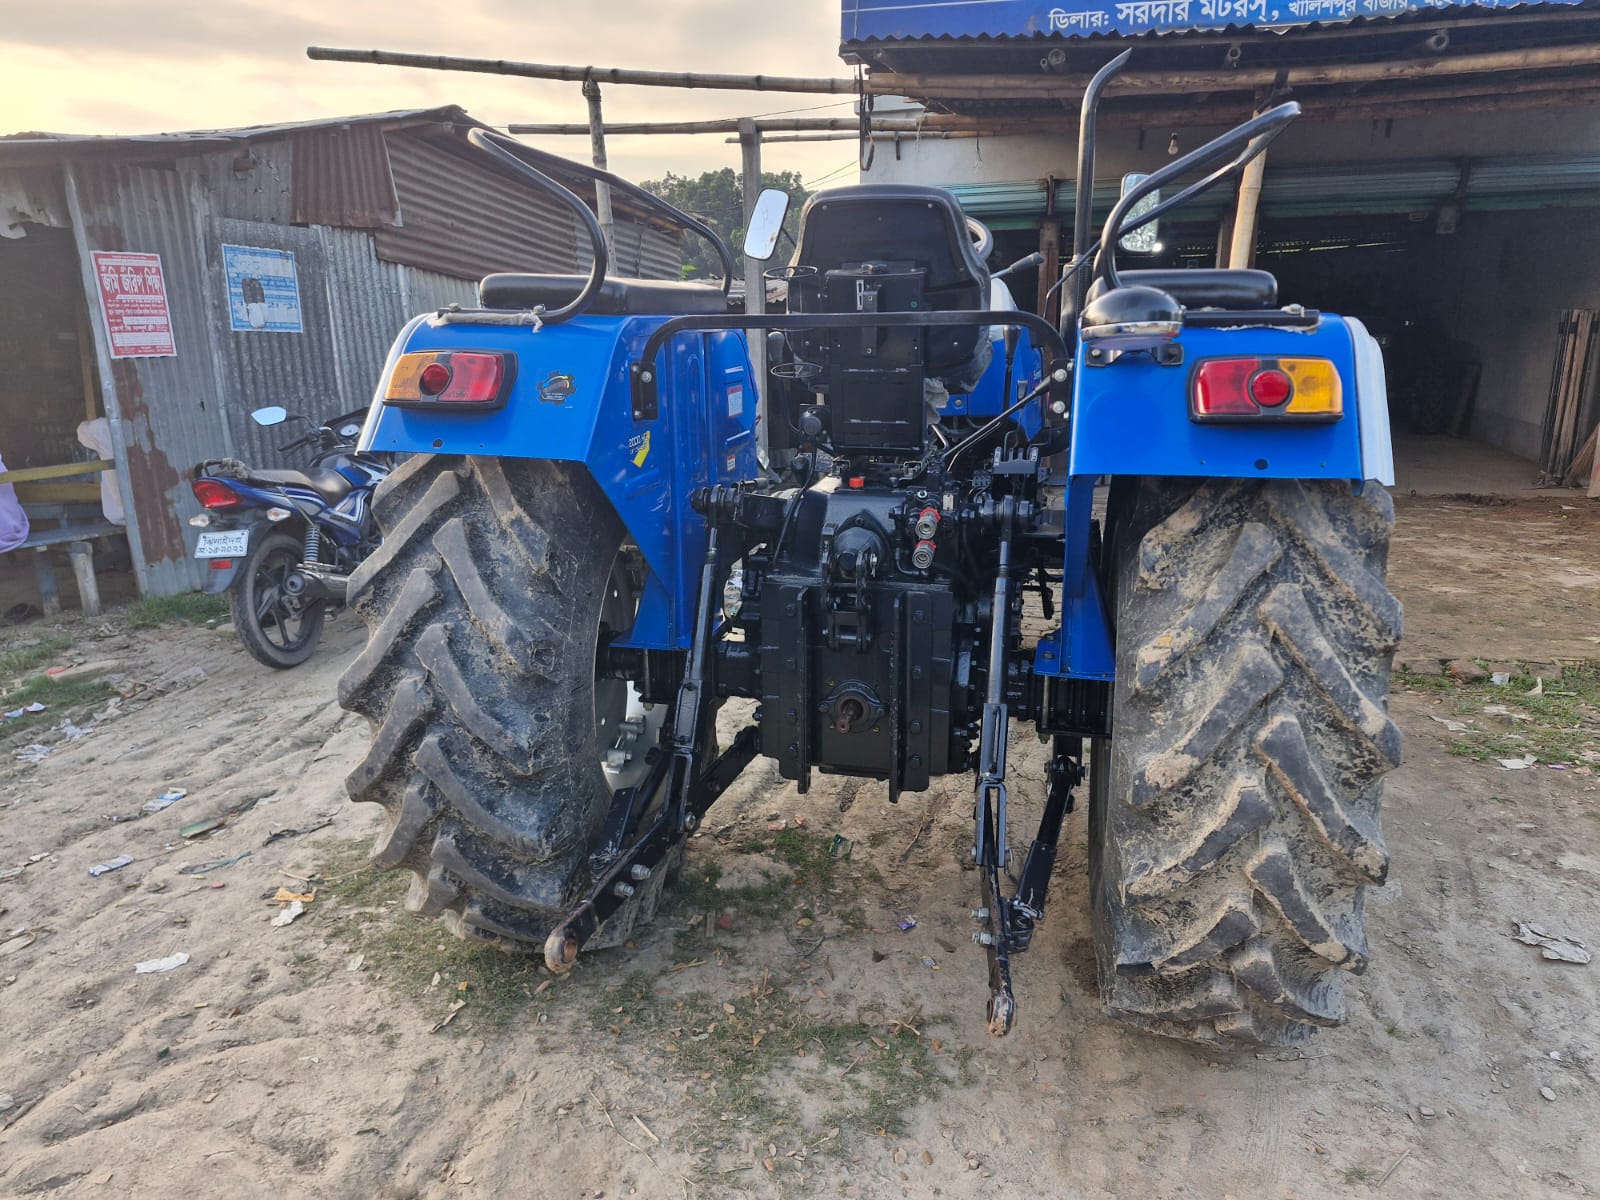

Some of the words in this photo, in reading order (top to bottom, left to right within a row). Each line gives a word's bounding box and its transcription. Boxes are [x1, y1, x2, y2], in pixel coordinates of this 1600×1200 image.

[1115, 0, 1190, 25] সরদার
[100, 266, 121, 293] জমি
[120, 266, 145, 294] জরিপ
